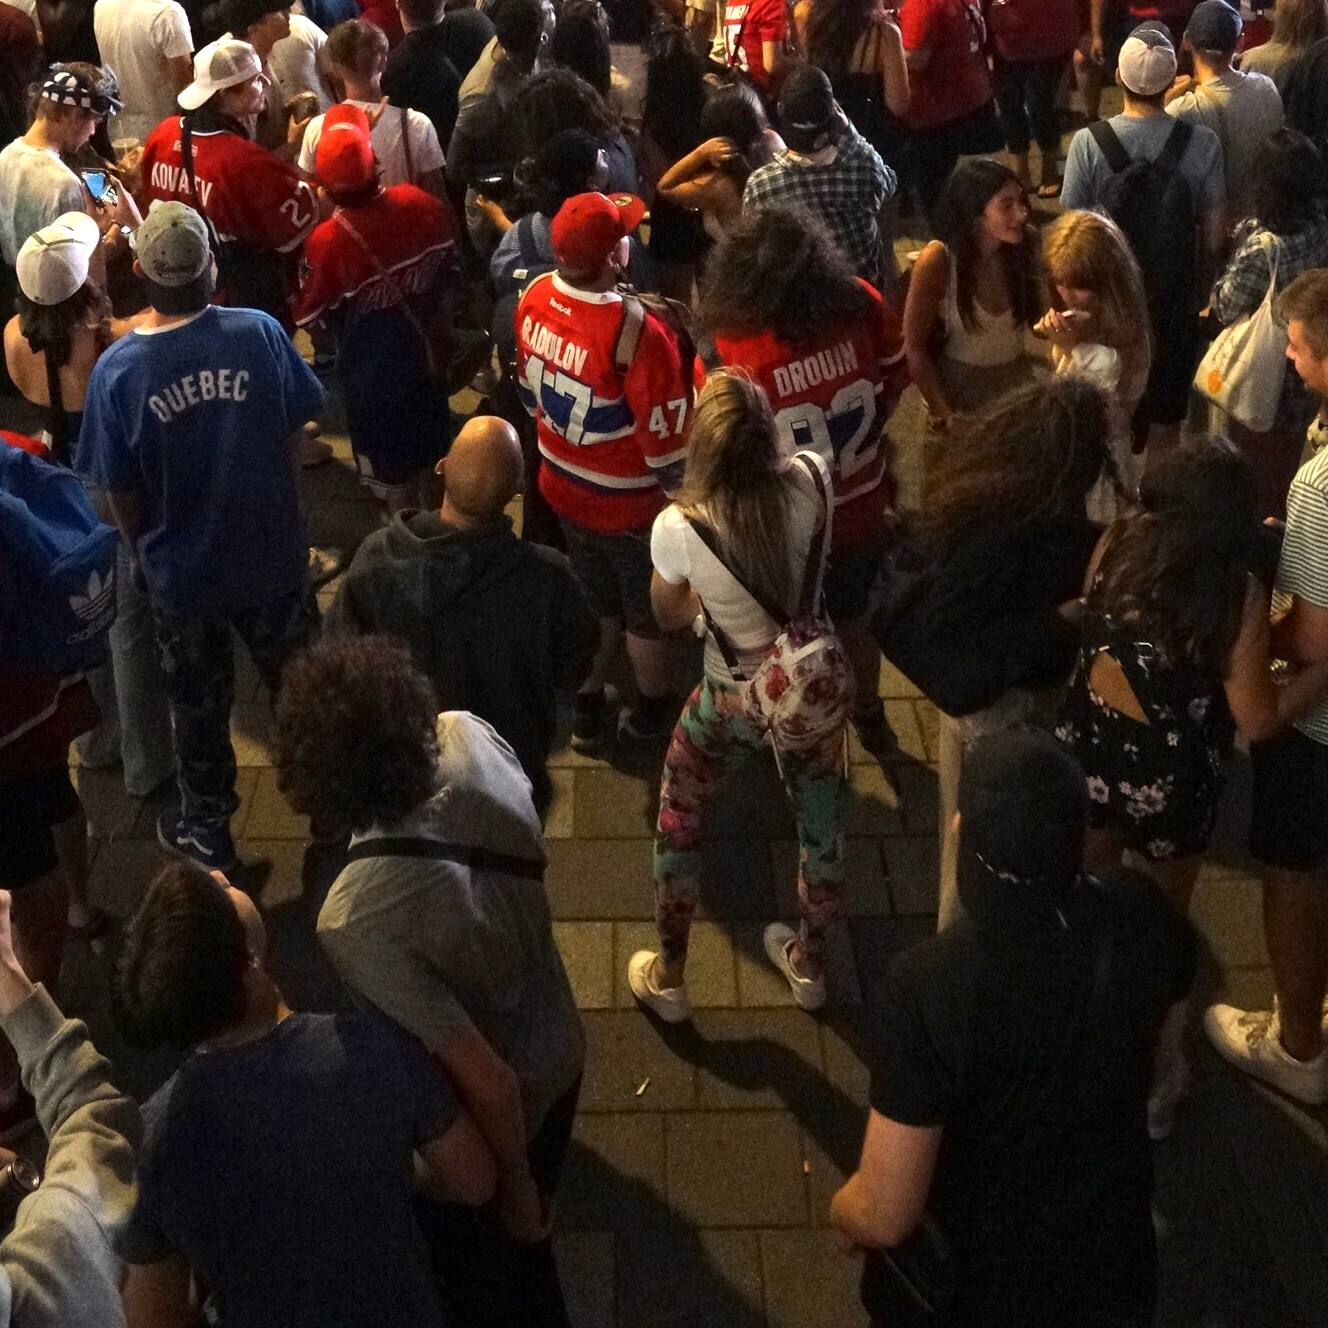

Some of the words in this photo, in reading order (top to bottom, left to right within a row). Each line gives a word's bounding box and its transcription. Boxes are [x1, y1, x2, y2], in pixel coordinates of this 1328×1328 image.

[522, 315, 589, 376] RADULOV
[773, 340, 859, 398] DROUIN
[148, 369, 250, 423] QUEBEC
[649, 397, 688, 440] 47
[774, 378, 878, 480] 92
